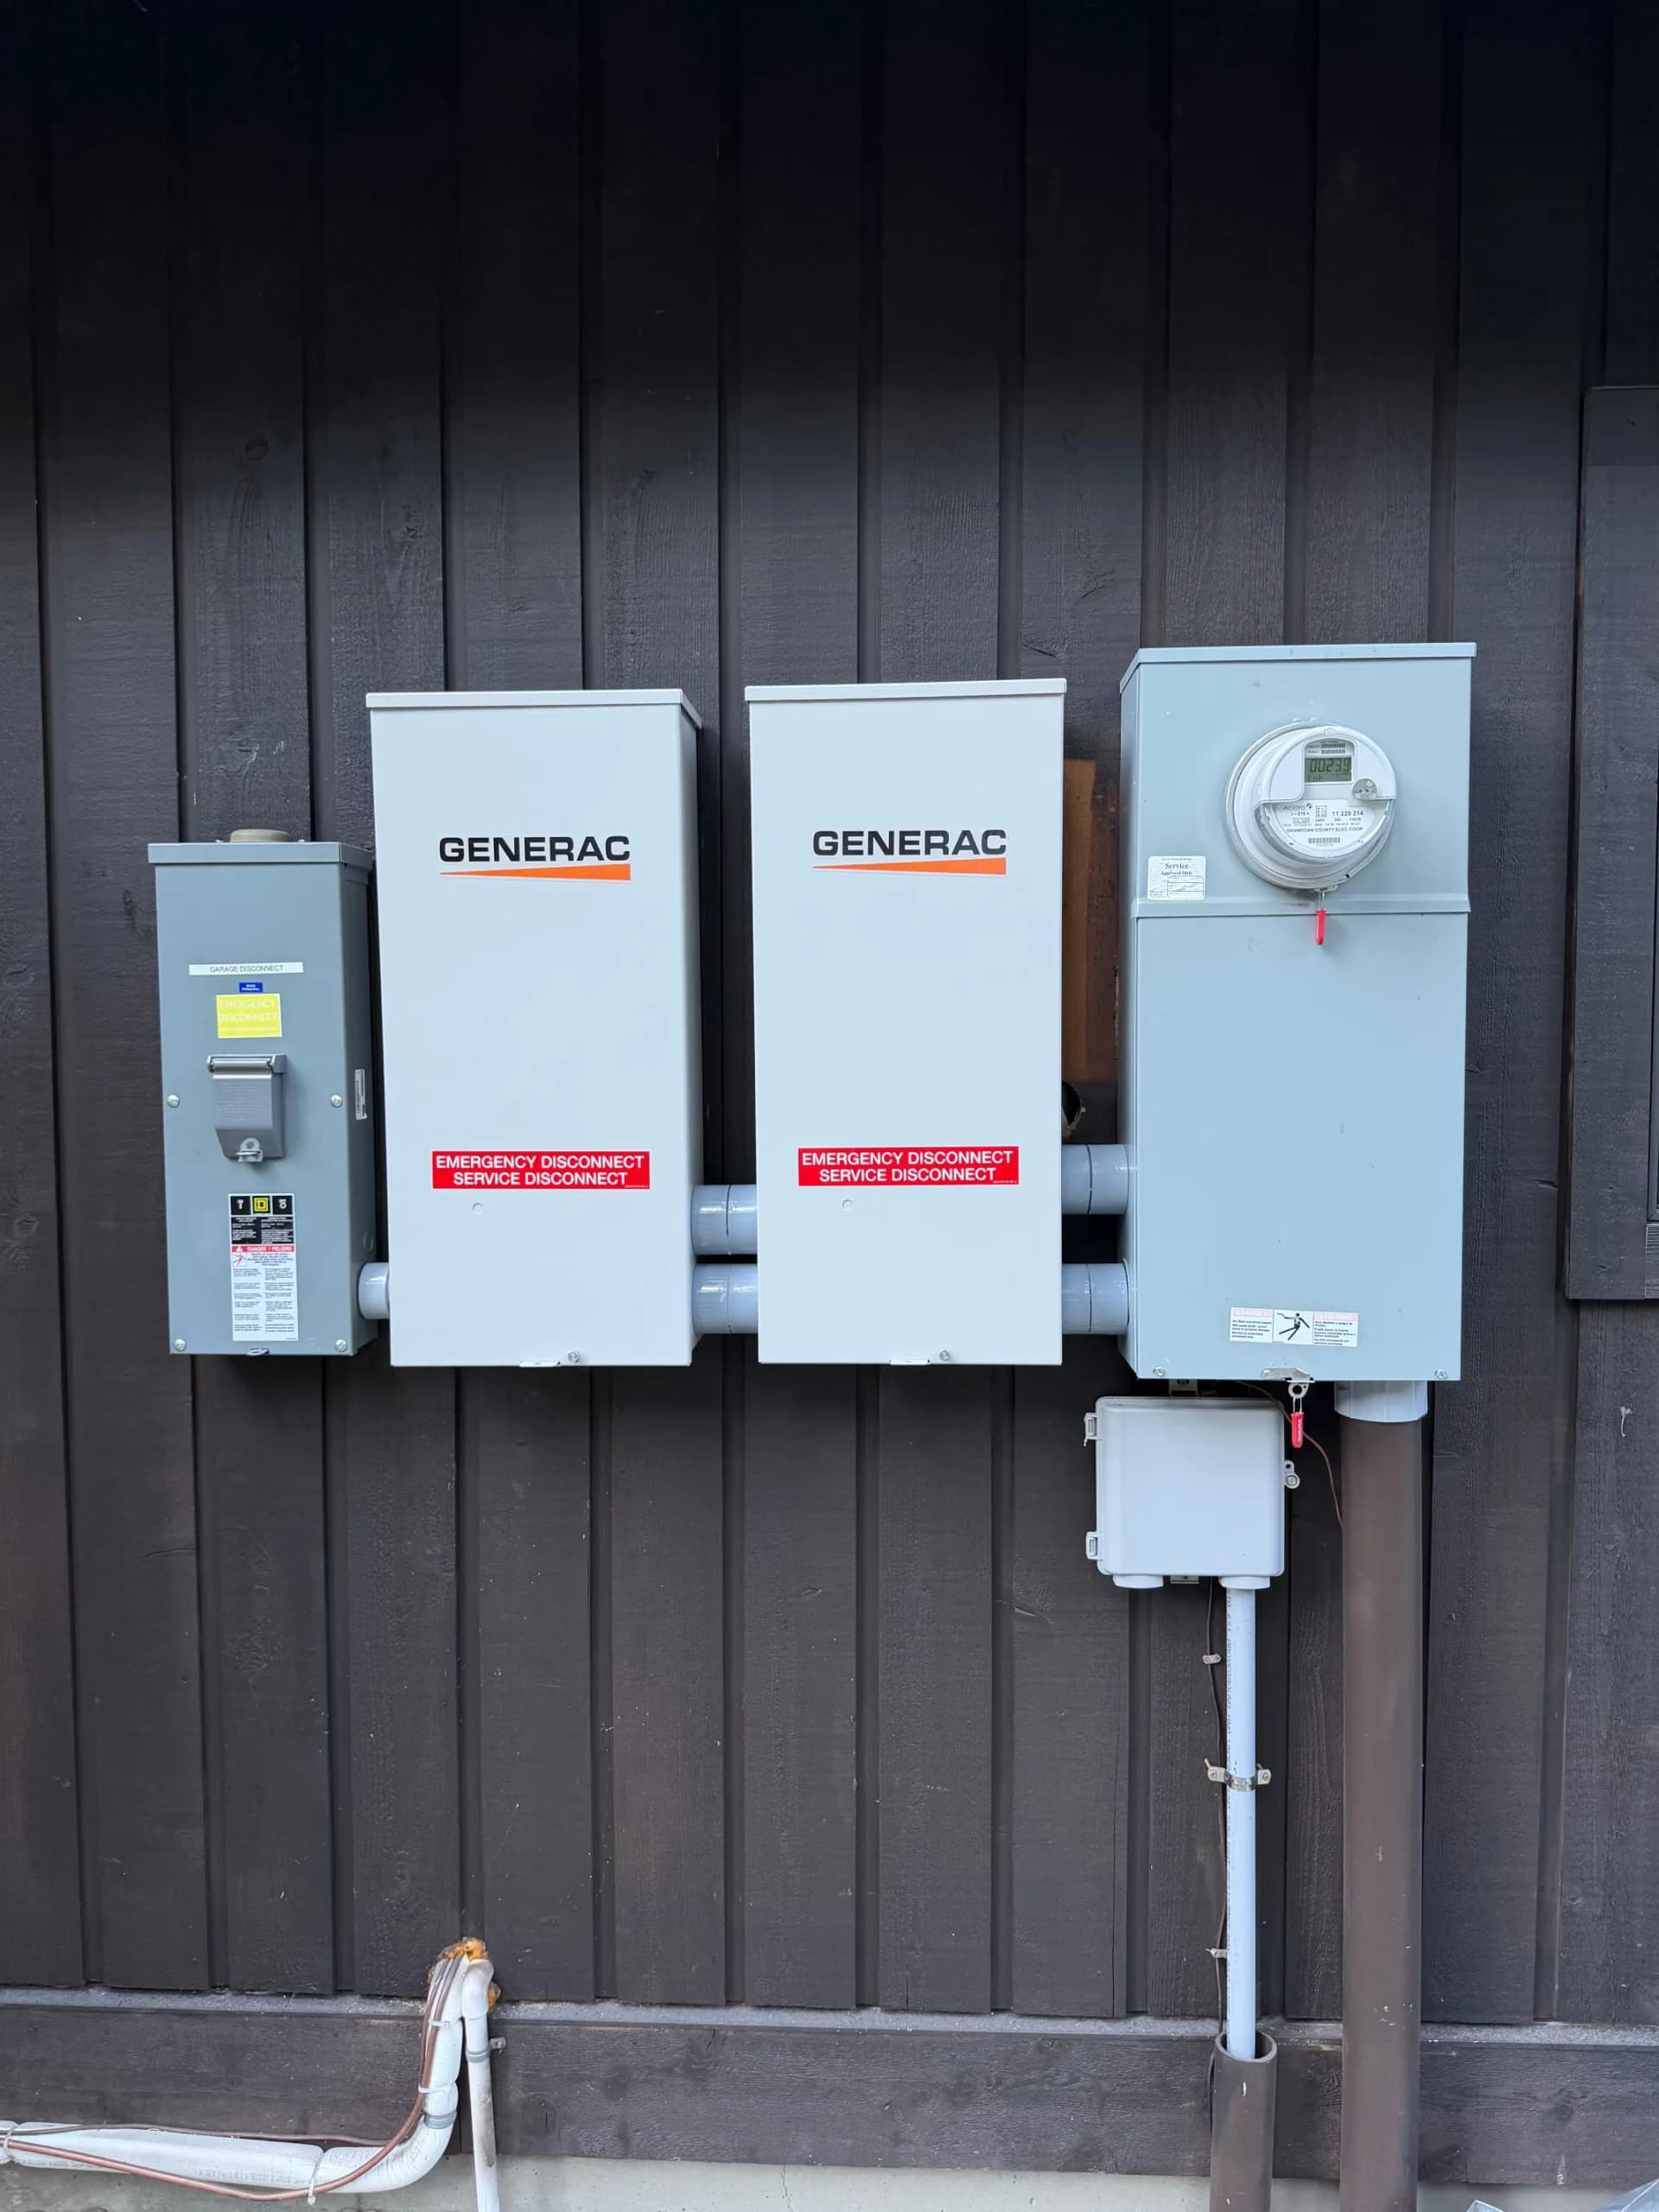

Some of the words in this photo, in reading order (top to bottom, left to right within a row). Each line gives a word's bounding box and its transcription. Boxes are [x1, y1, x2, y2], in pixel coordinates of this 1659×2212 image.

[439, 836, 630, 862] GENERAC
[813, 830, 1007, 855] GENERAC
[436, 1155, 537, 1169] EMERGENCY
[541, 1155, 645, 1169] DISCONNECT
[802, 1152, 903, 1166] EMERGENCY
[907, 1151, 1014, 1165] DISCONNECT
[454, 1172, 520, 1185] SERVICE
[524, 1172, 628, 1185] DISCONNECT
[819, 1168, 887, 1182] SERVICE
[892, 1167, 996, 1182] DISCONNECT
